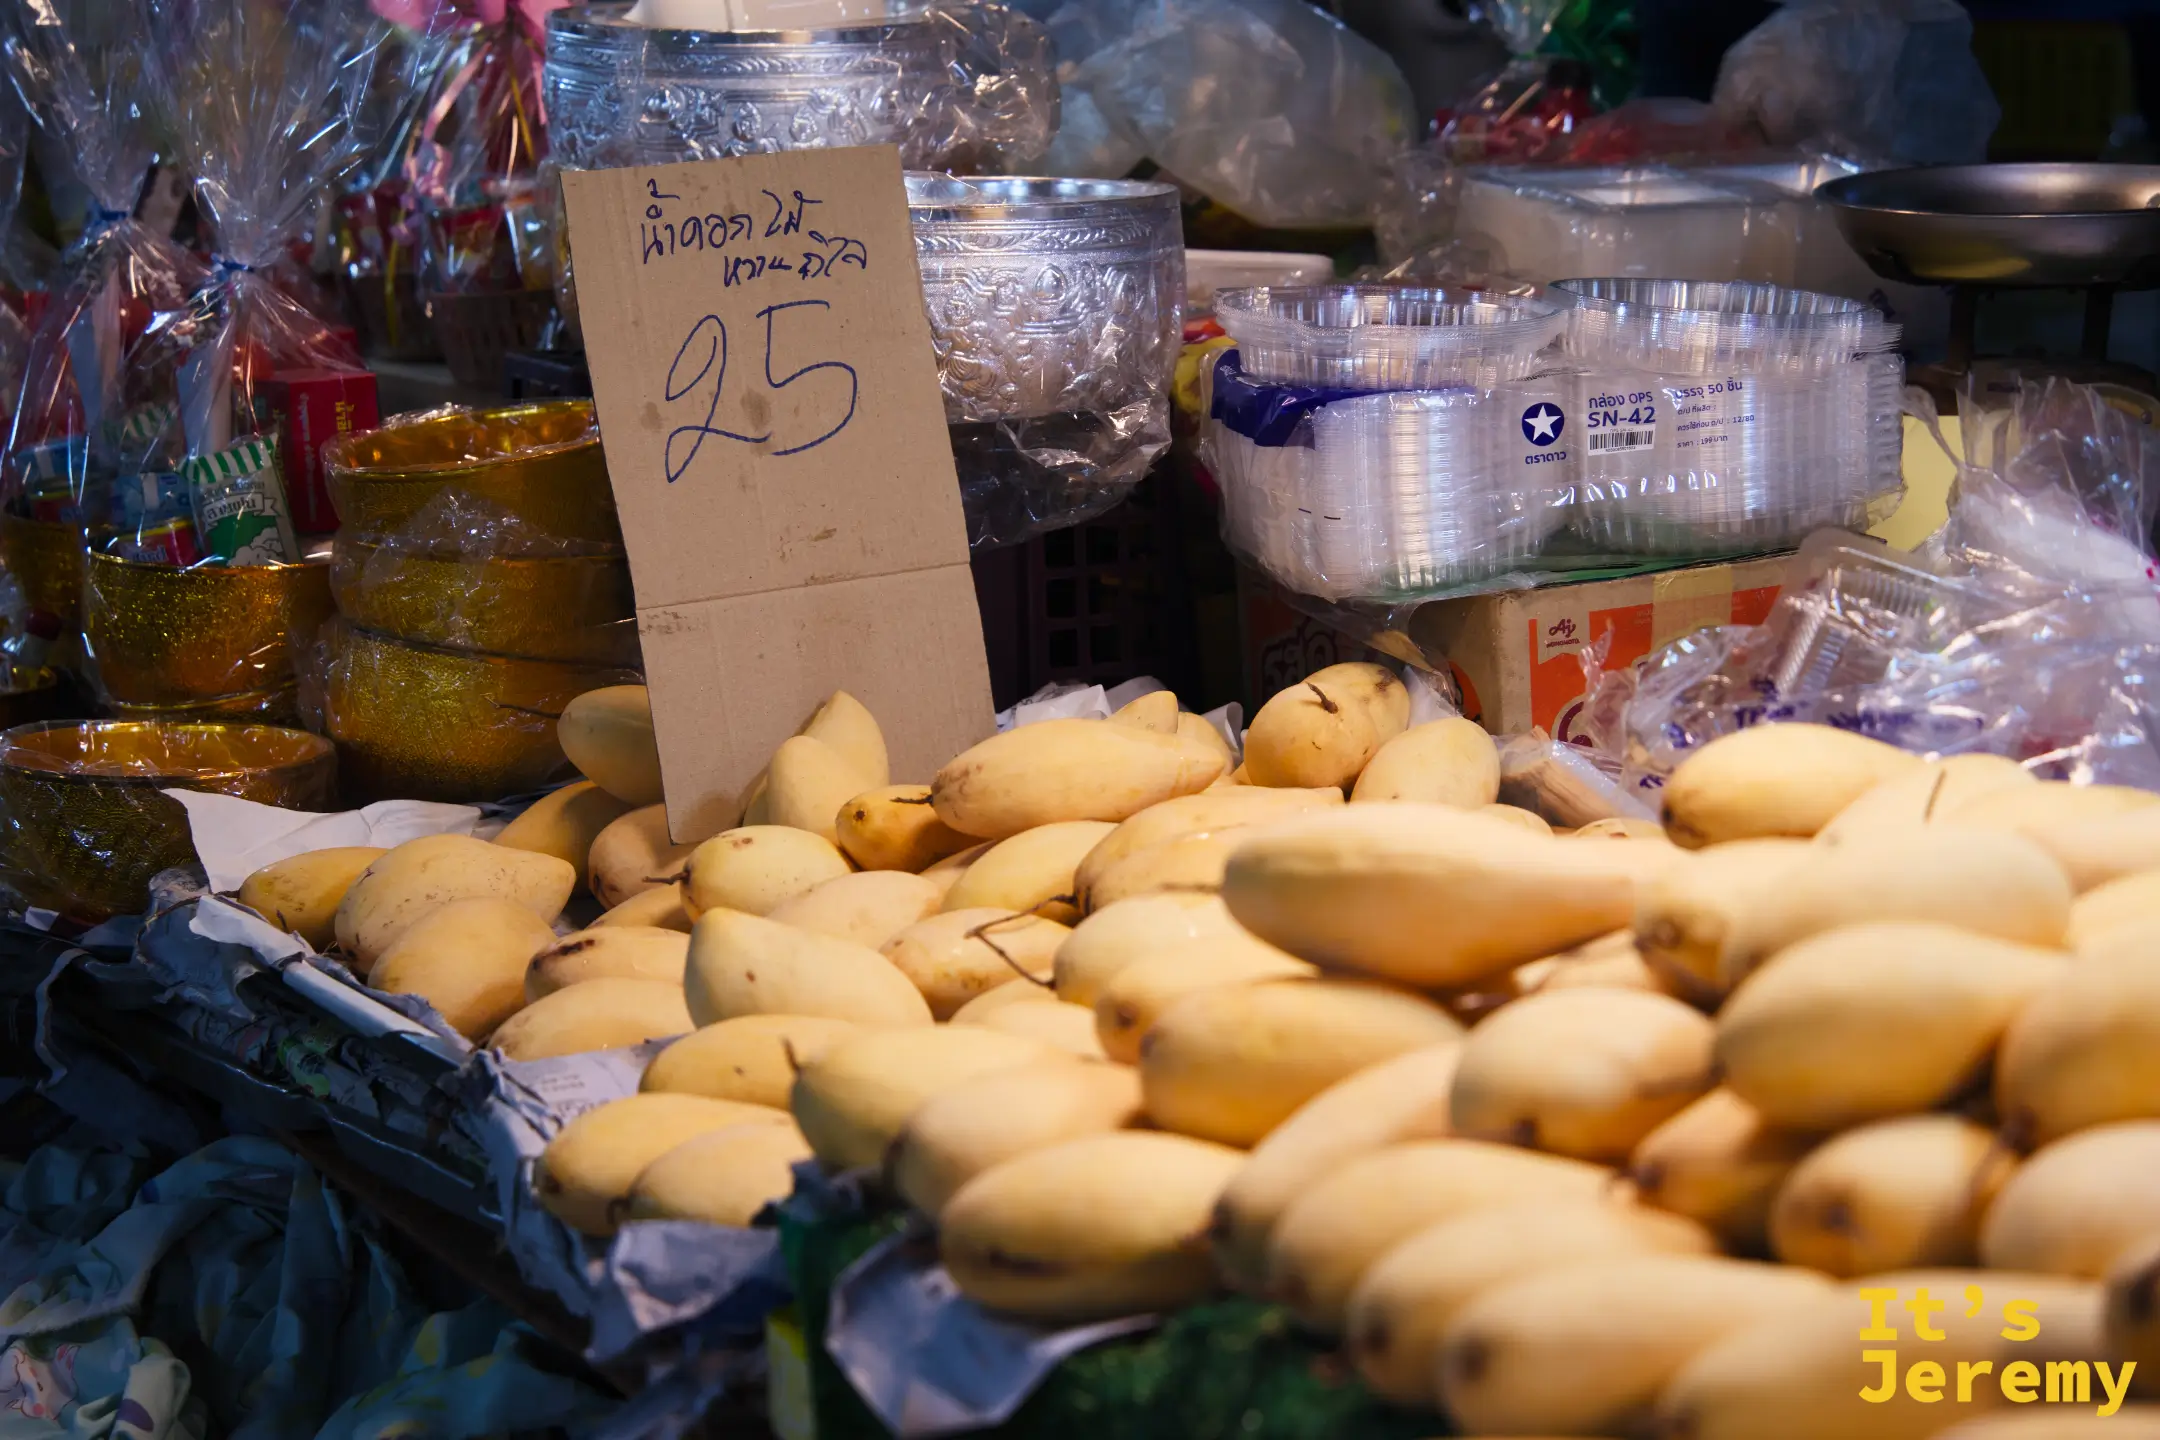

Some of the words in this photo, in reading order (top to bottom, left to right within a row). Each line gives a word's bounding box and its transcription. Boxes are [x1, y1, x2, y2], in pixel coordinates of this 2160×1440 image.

[665, 300, 857, 483] 25
[1707, 382, 1724, 395] 50
[1726, 376, 1743, 392] ชิ้น
[1588, 392, 1625, 408] กล่อง
[1628, 391, 1654, 404] OPS
[1587, 406, 1656, 428] SN-42
[1525, 450, 1567, 465] ตราดาว
